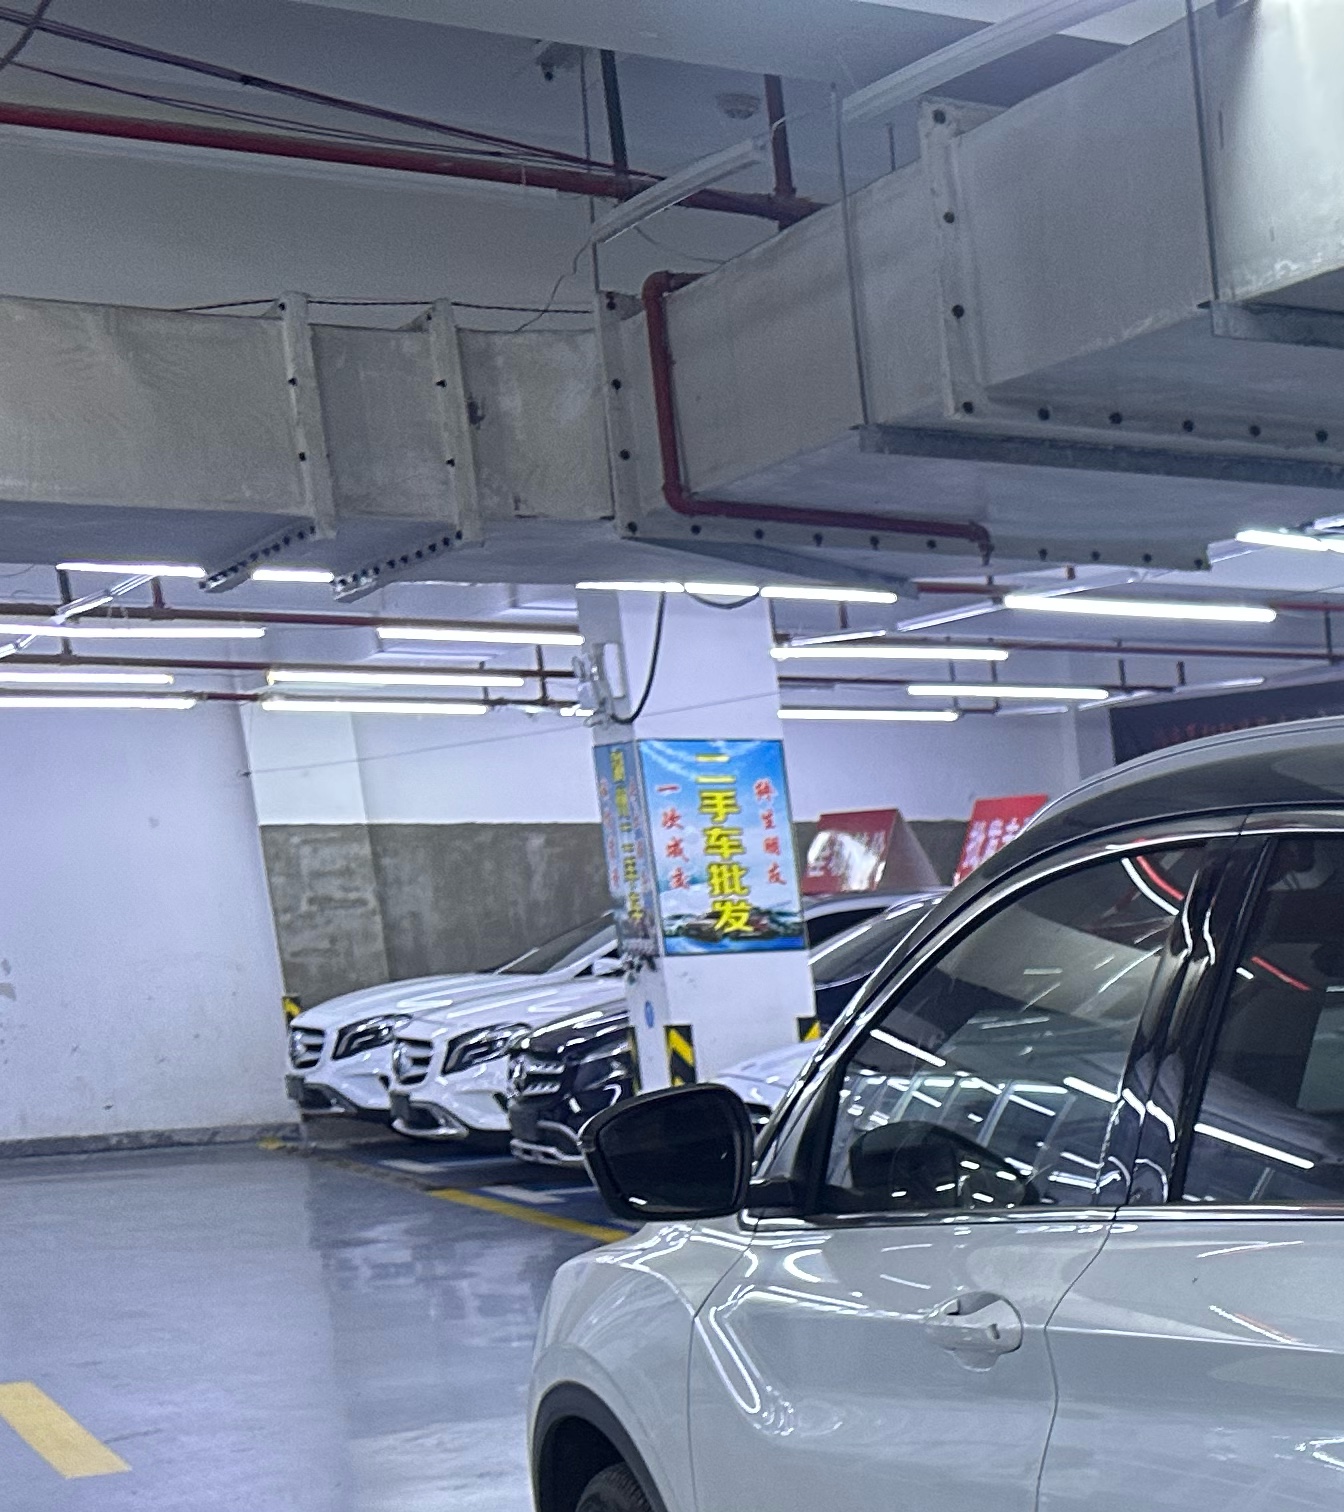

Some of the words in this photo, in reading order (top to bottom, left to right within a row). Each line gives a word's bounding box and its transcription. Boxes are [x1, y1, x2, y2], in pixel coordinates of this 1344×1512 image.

[695, 753, 754, 933] 二手车批发
